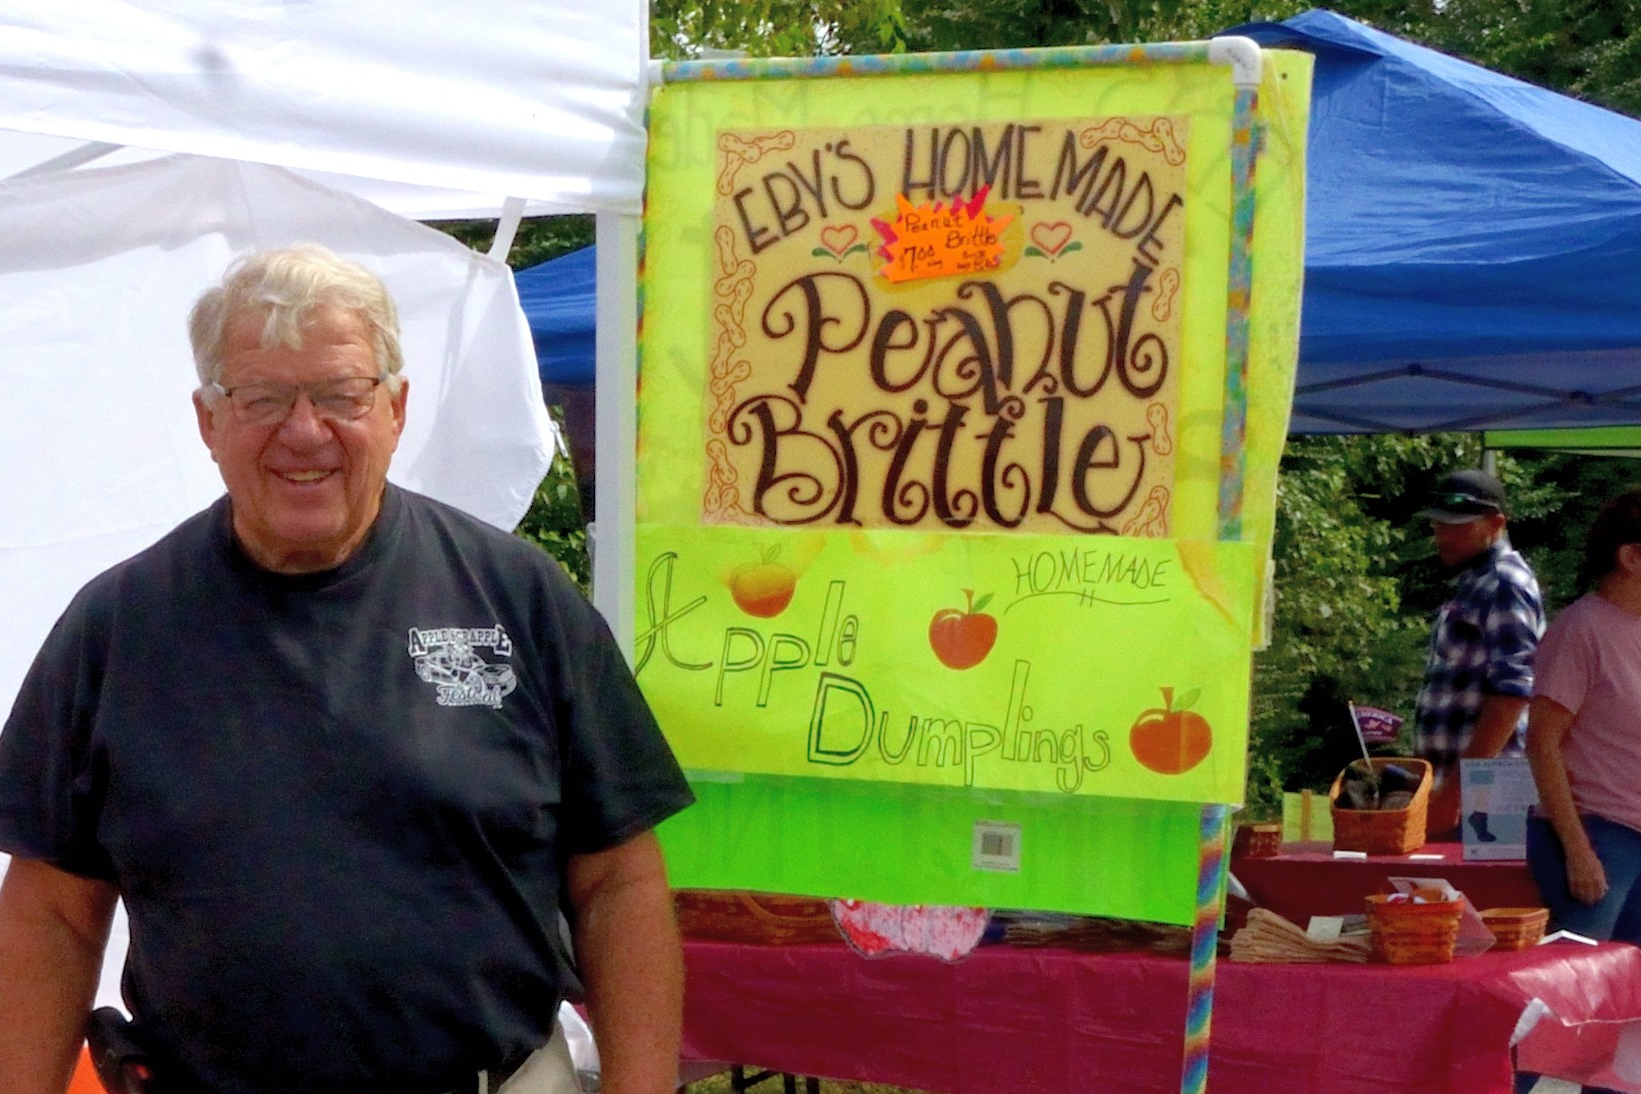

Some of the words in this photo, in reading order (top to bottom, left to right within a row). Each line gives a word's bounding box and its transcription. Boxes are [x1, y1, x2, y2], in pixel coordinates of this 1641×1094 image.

[731, 138, 877, 255] EBY'S
[904, 212, 964, 234] Peanut
[944, 225, 999, 249] Brittle
[761, 258, 1169, 416] Peanut
[726, 391, 1152, 536] Brittle
[634, 551, 859, 707] Apple
[1013, 548, 1172, 594] HOMEMADE
[806, 659, 1111, 793] Dumplings
